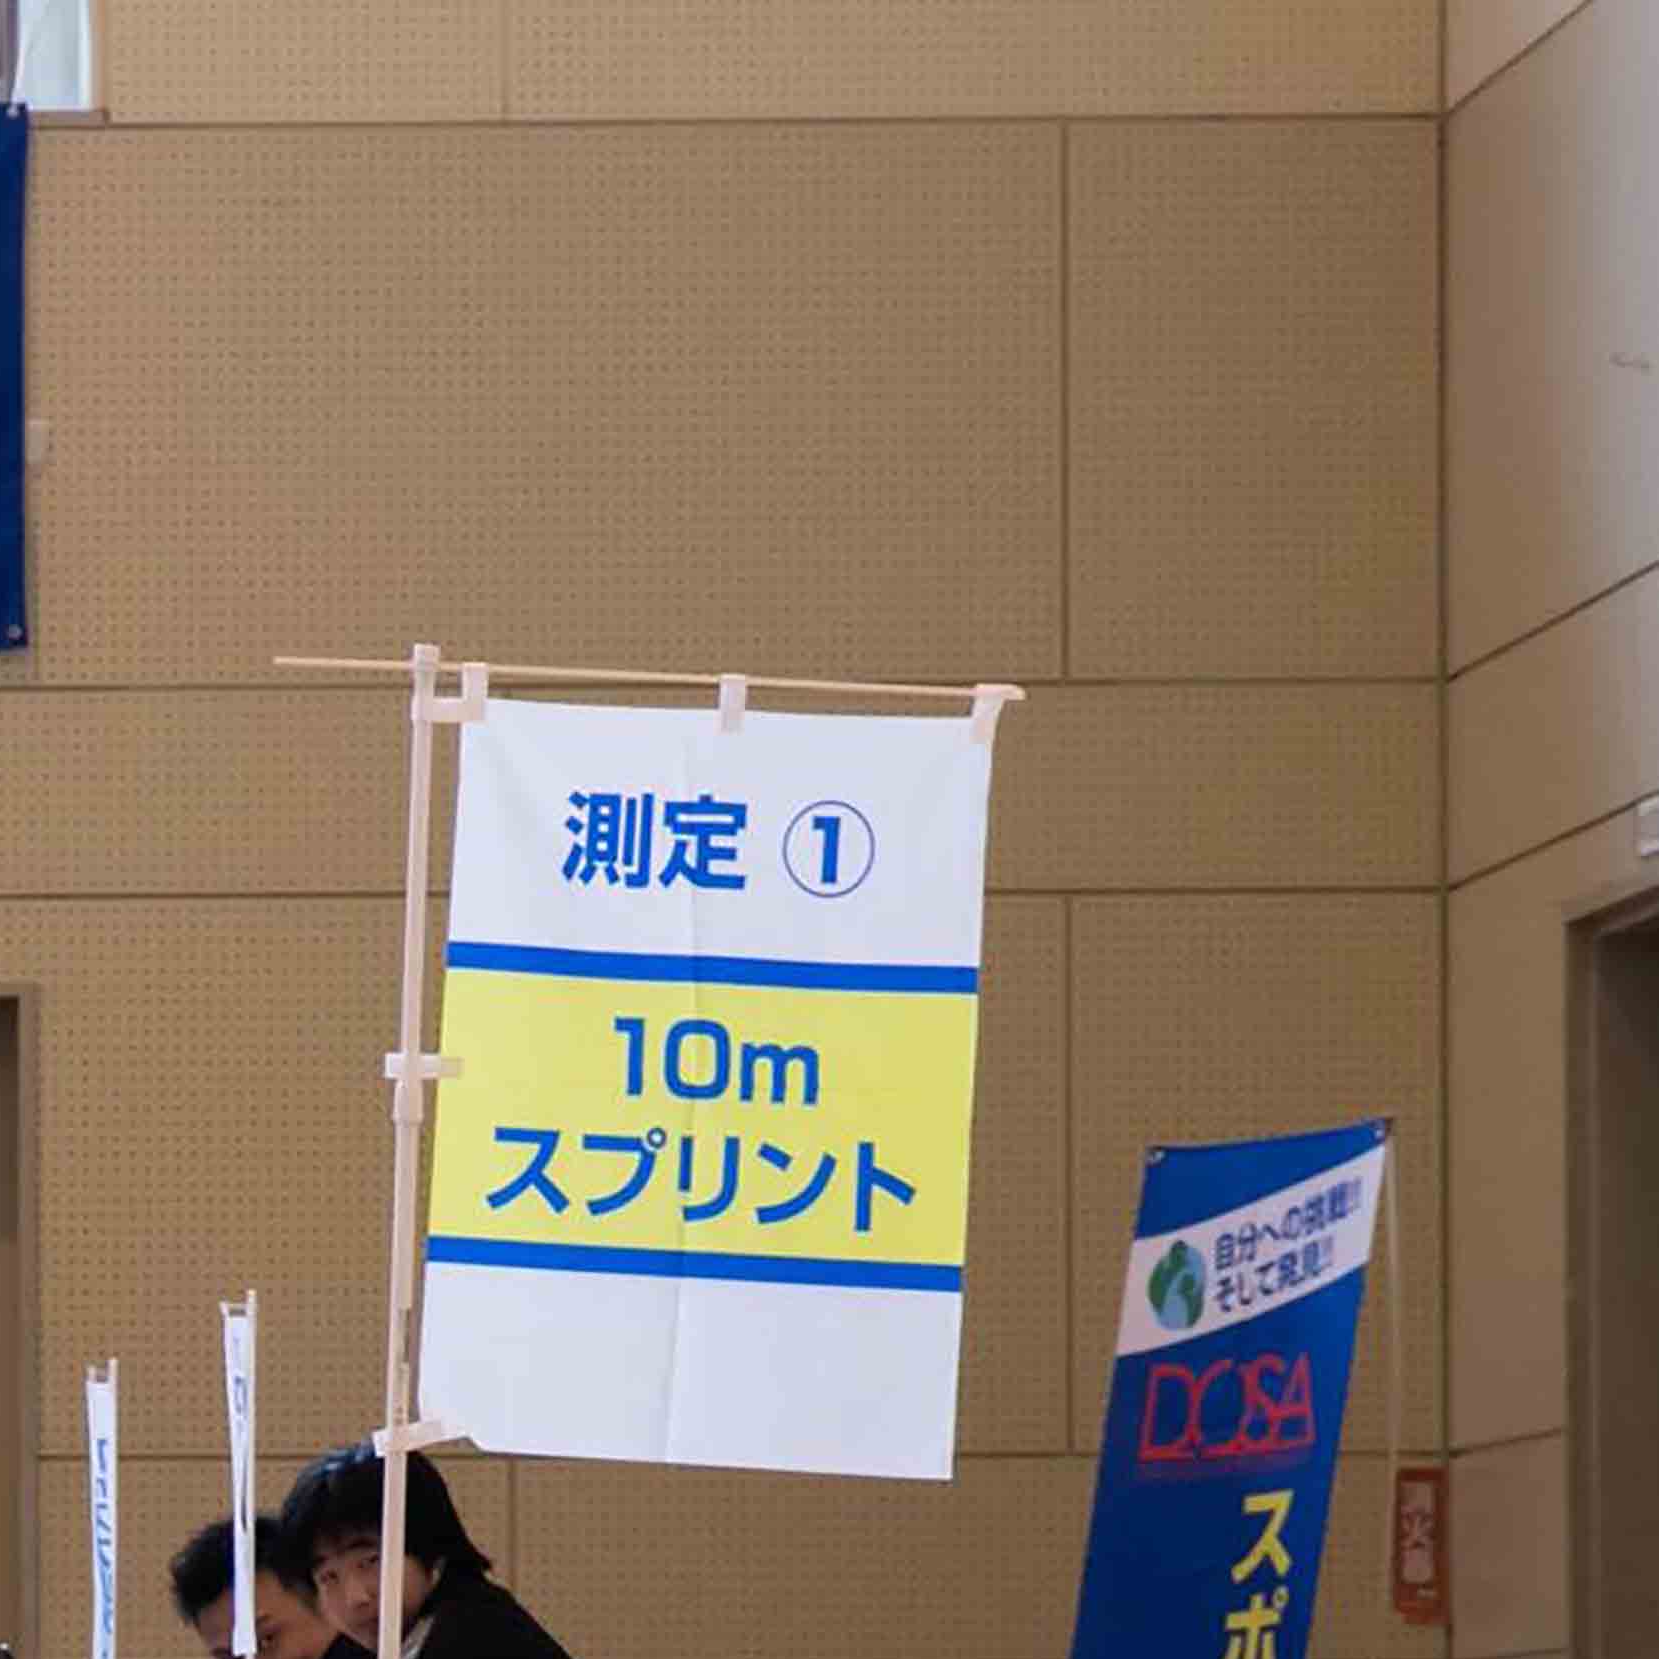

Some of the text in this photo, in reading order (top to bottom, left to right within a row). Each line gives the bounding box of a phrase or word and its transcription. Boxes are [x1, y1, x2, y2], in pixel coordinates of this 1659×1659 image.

[561, 790, 749, 891] 測定
[613, 1016, 819, 1106] 10m
[485, 1125, 917, 1233] スプリント
